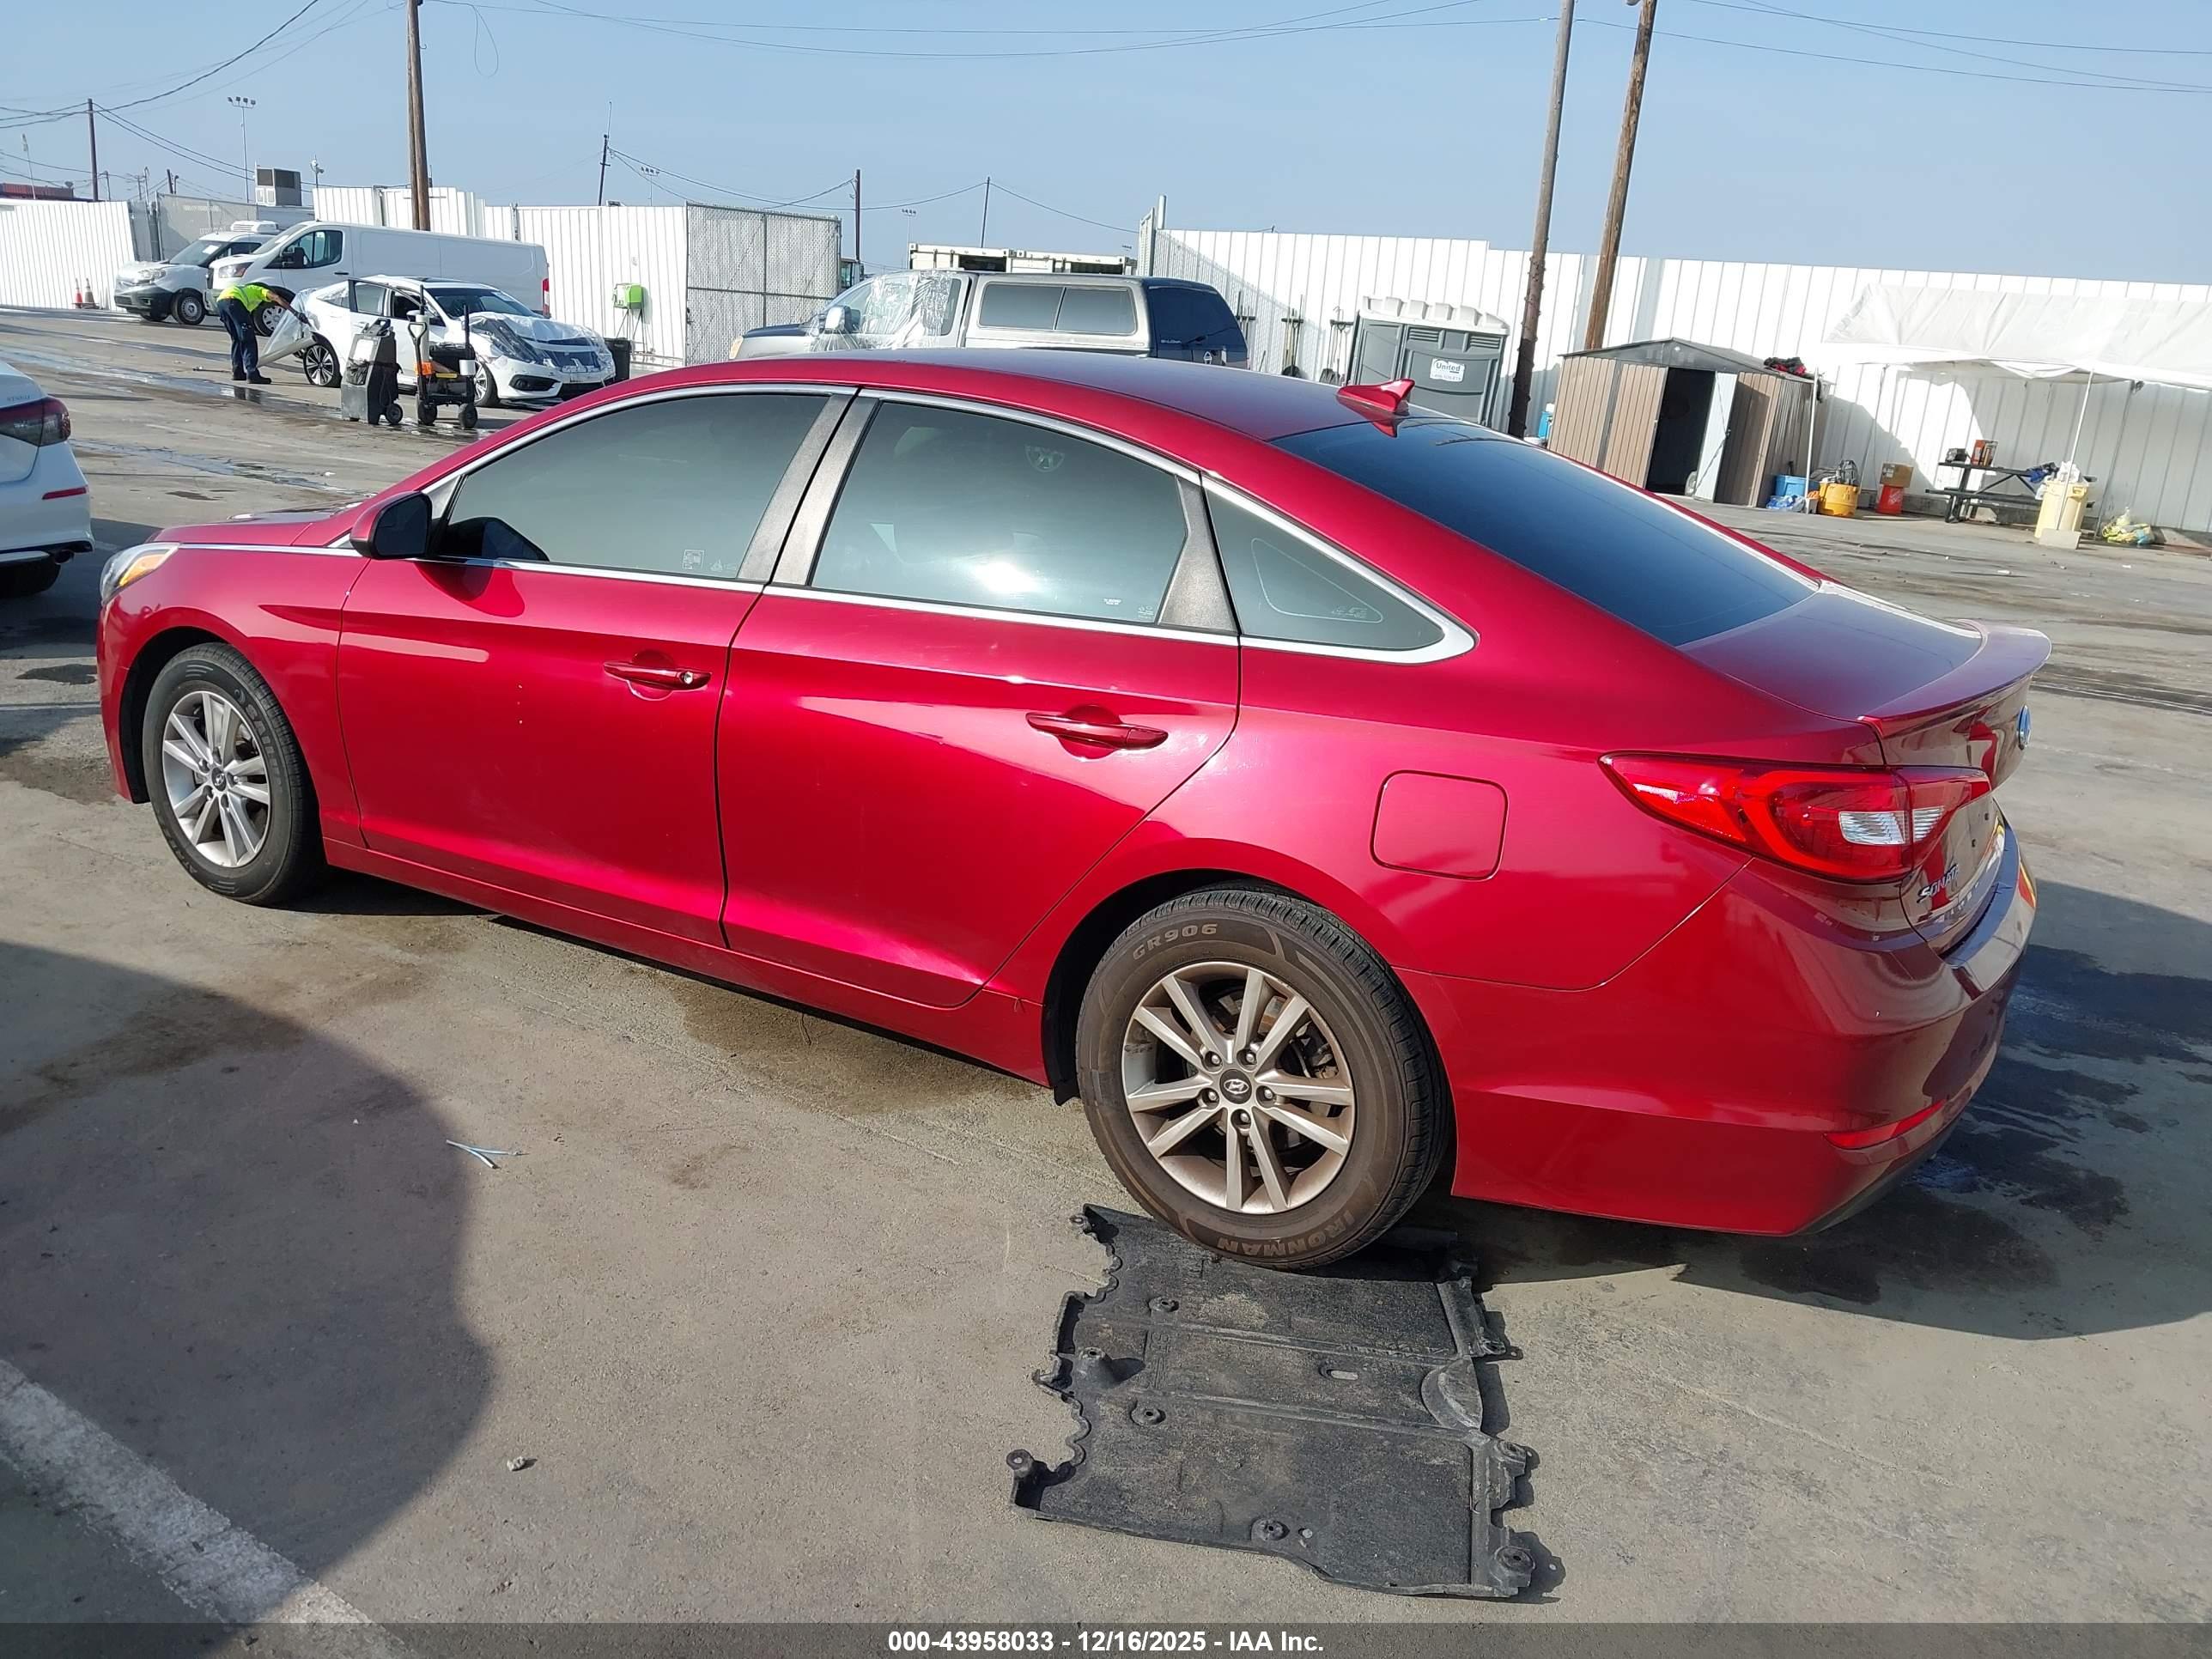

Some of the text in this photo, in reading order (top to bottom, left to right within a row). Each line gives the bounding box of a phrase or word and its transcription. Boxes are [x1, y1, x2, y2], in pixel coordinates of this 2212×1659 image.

[1436, 362, 1461, 372] United
[1133, 923, 1218, 960] GR906
[1217, 1210, 1355, 1257] IRONMAN
